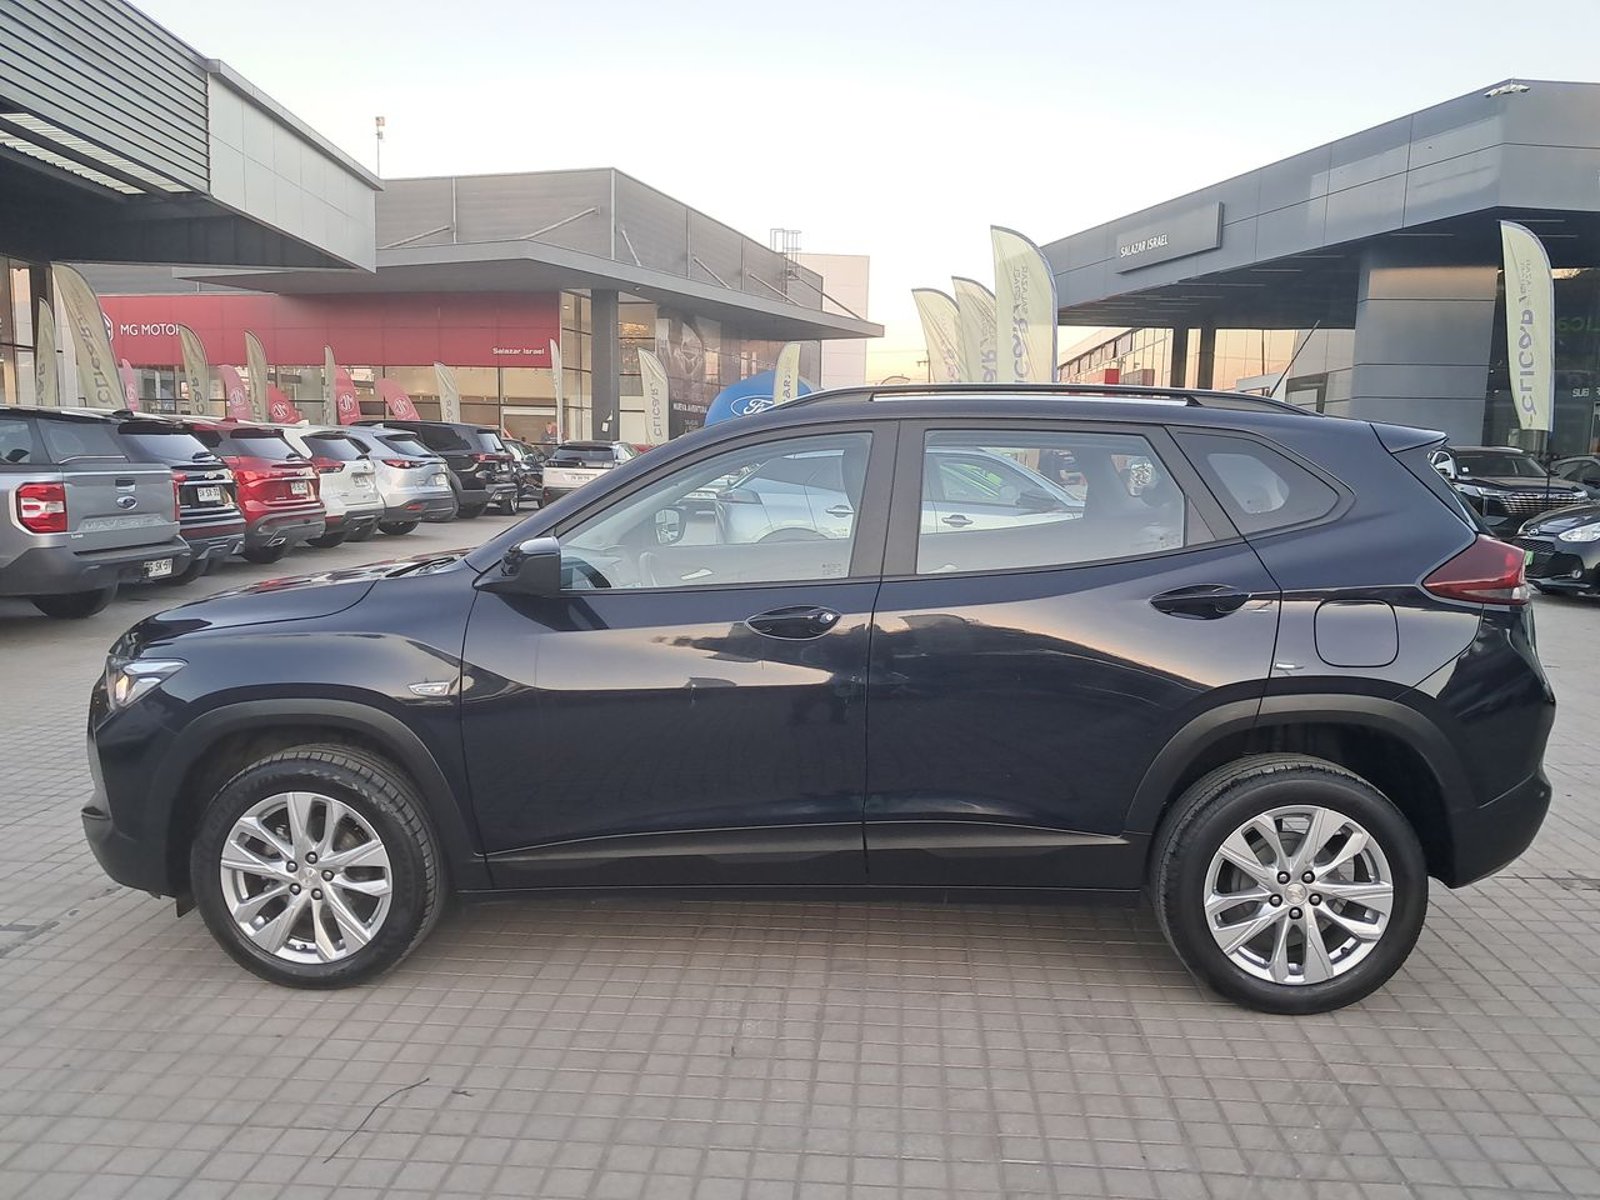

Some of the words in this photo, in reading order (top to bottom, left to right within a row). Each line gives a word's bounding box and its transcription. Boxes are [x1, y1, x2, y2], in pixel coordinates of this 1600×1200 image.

[1120, 241, 1147, 258] SALAZAR
[1147, 234, 1169, 250] ISRAEL
[120, 324, 138, 336] MG
[492, 347, 521, 355] Salazar
[523, 347, 545, 355] Israel
